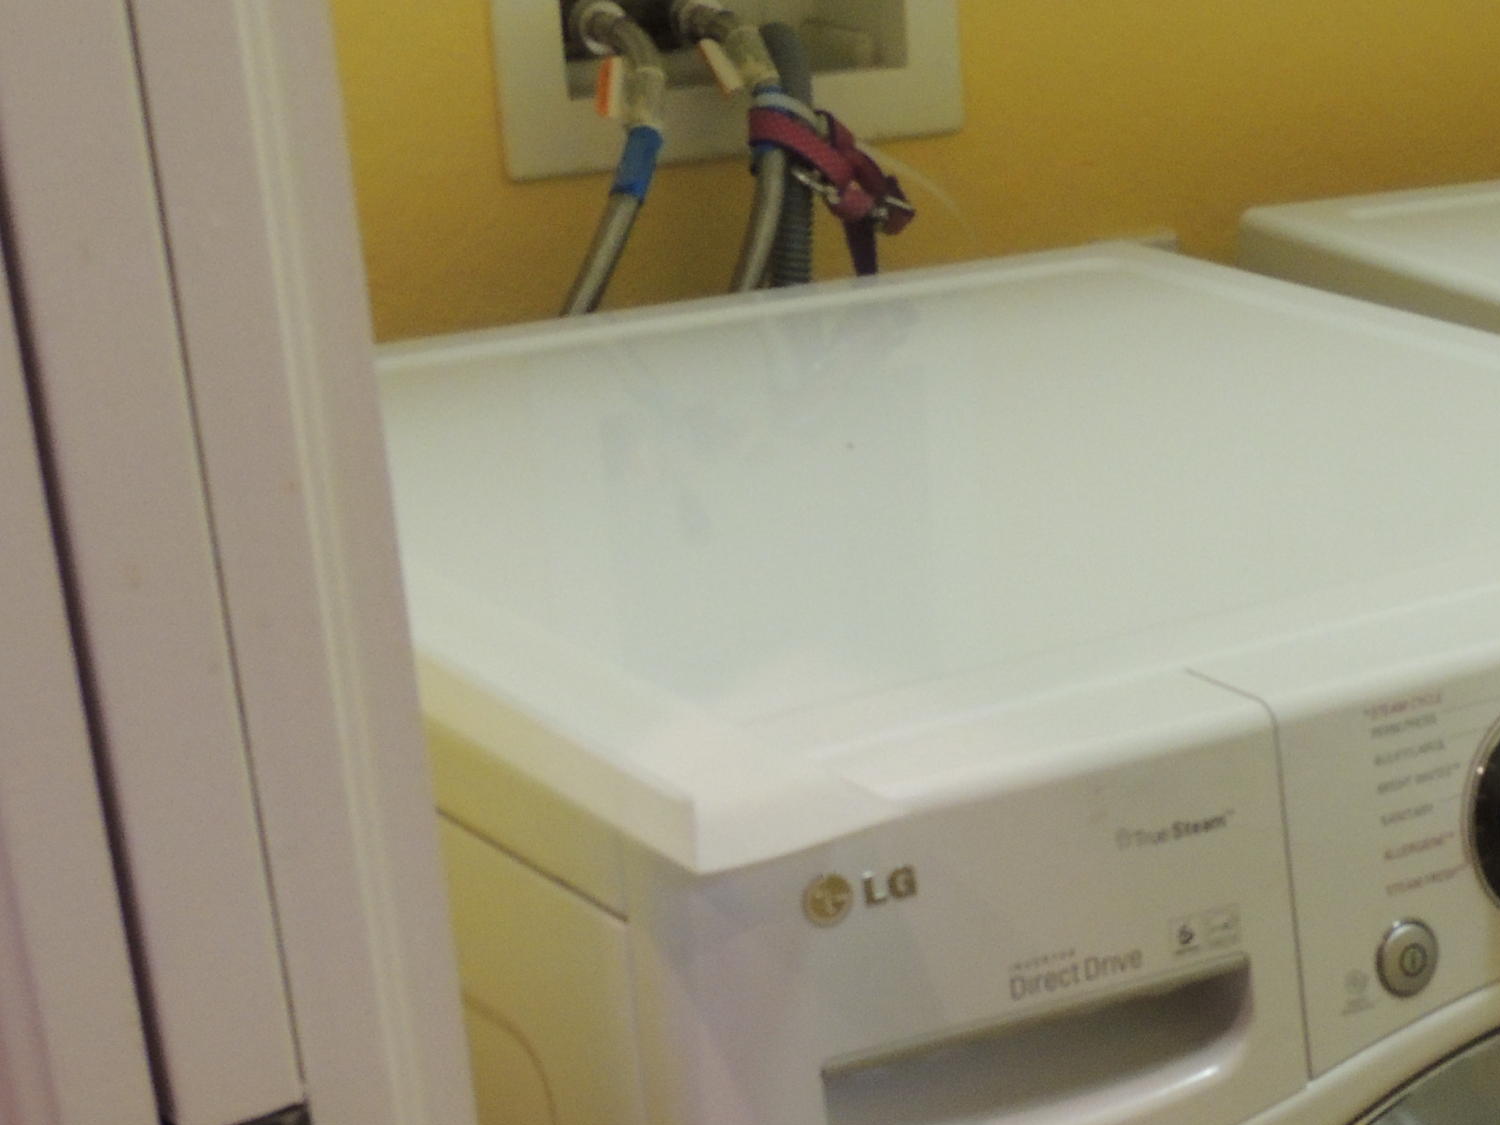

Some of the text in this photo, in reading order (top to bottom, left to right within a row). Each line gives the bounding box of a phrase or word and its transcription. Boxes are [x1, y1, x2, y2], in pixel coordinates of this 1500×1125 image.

[863, 865, 918, 908] LG
[1009, 962, 1081, 1001] Direct
[1084, 949, 1143, 982] Drive
